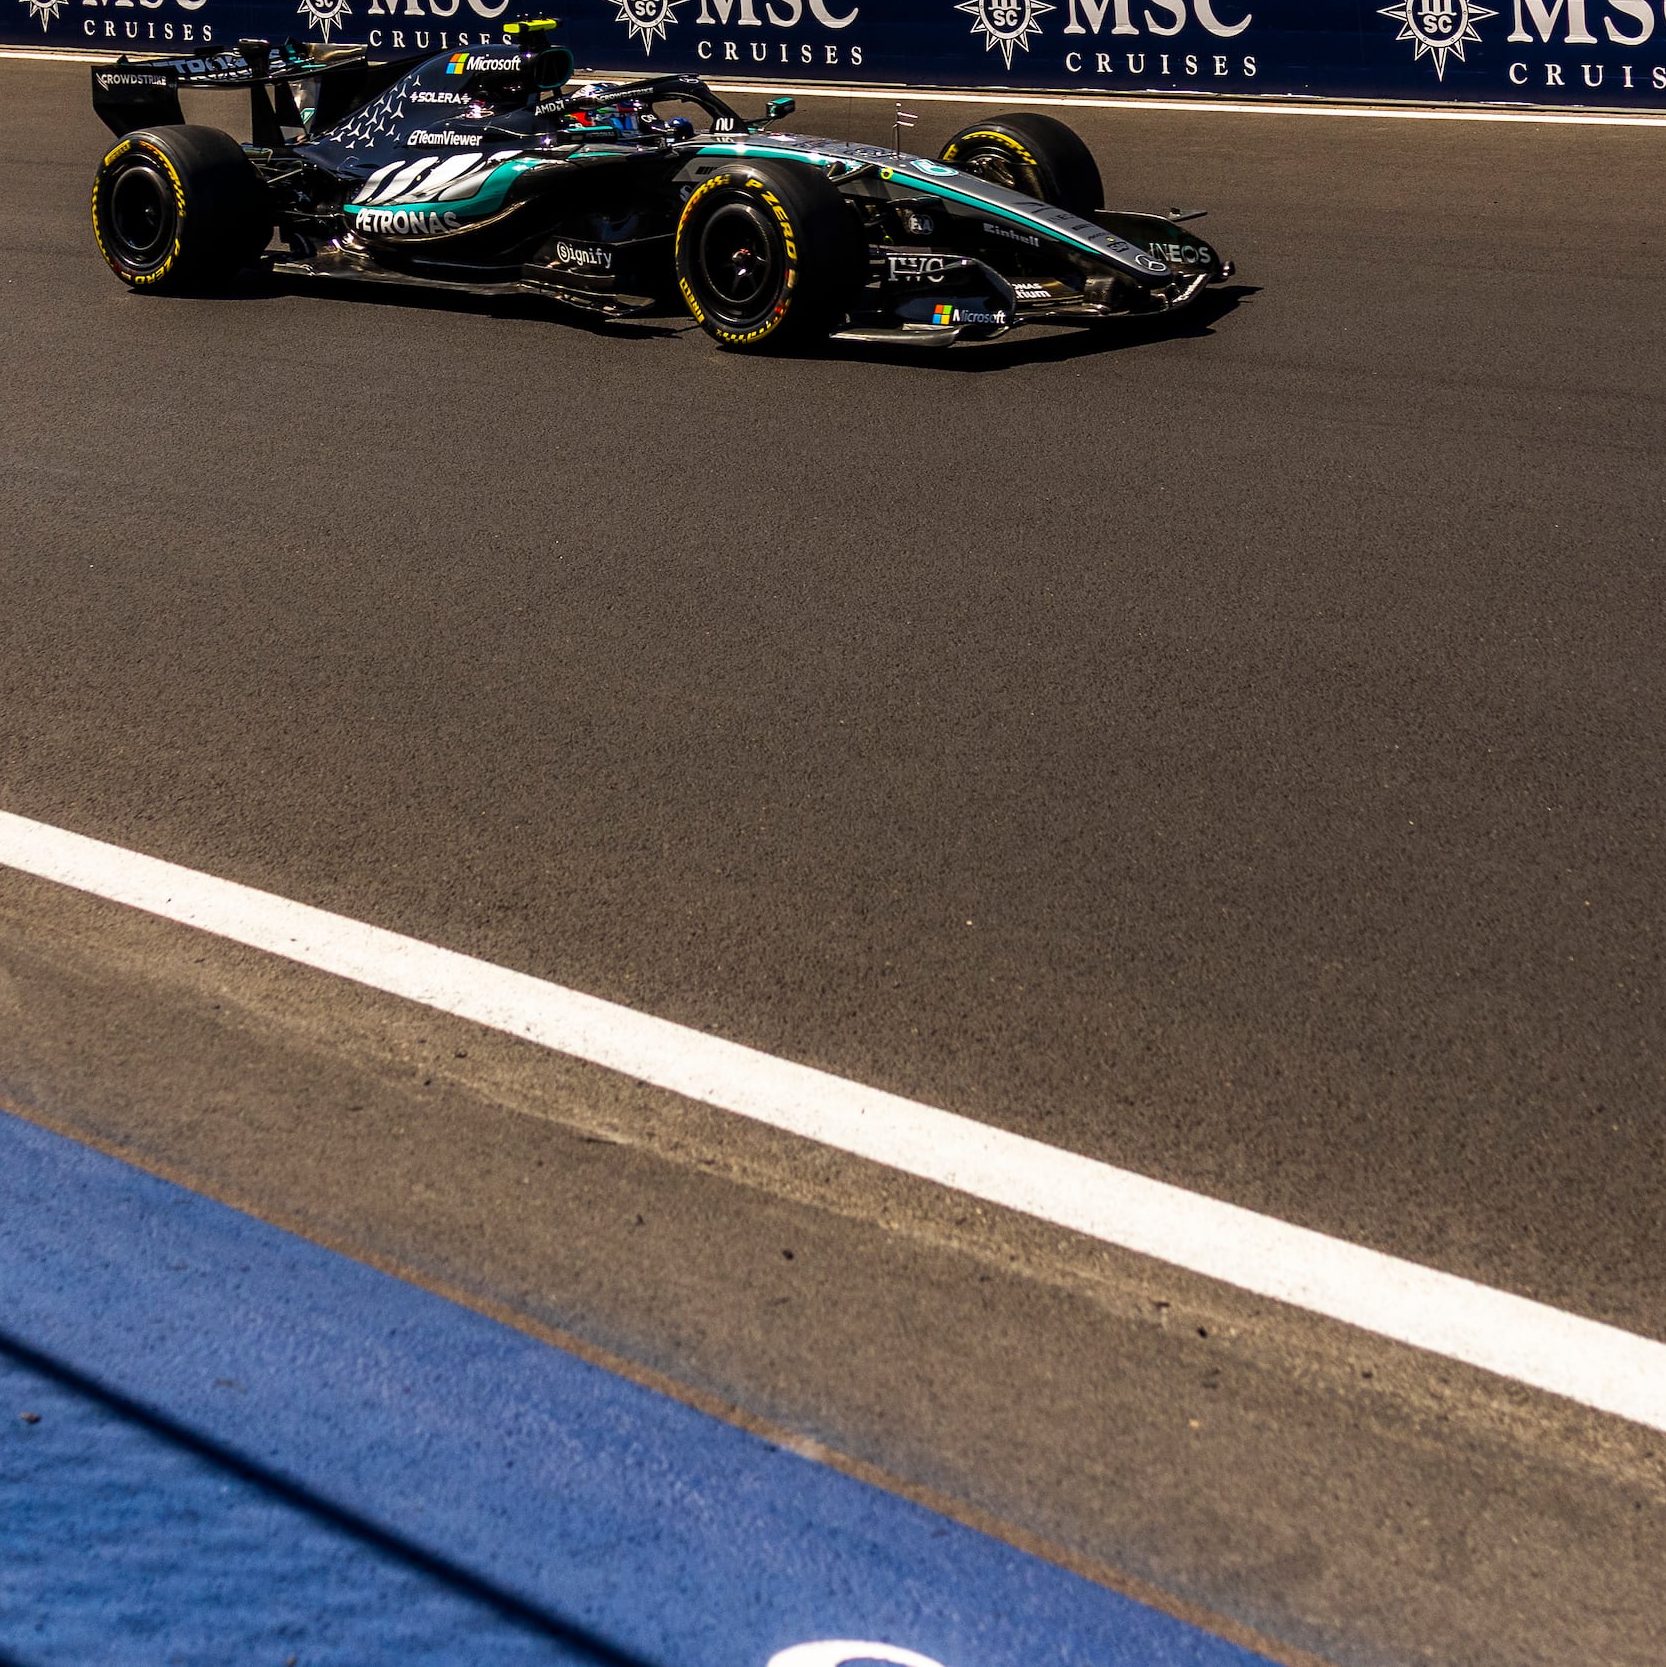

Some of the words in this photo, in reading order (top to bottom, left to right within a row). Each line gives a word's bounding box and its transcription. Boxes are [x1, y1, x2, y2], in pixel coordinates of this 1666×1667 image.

[84, 20, 212, 41] CRUISES
[370, 30, 512, 49] CRUISES
[698, 41, 863, 65] CRUISES
[466, 54, 522, 72] Microsoft
[1066, 52, 1257, 76] CRUISES
[101, 72, 167, 86] CROWDSTRIKE
[418, 92, 461, 104] SOLERA
[534, 103, 556, 117] AMD
[419, 130, 483, 147] TeamViewer
[355, 207, 464, 235] PETRONAS
[1148, 242, 1212, 265] INEOS
[887, 255, 946, 282] IWC
[952, 308, 1007, 324] Microsoft
